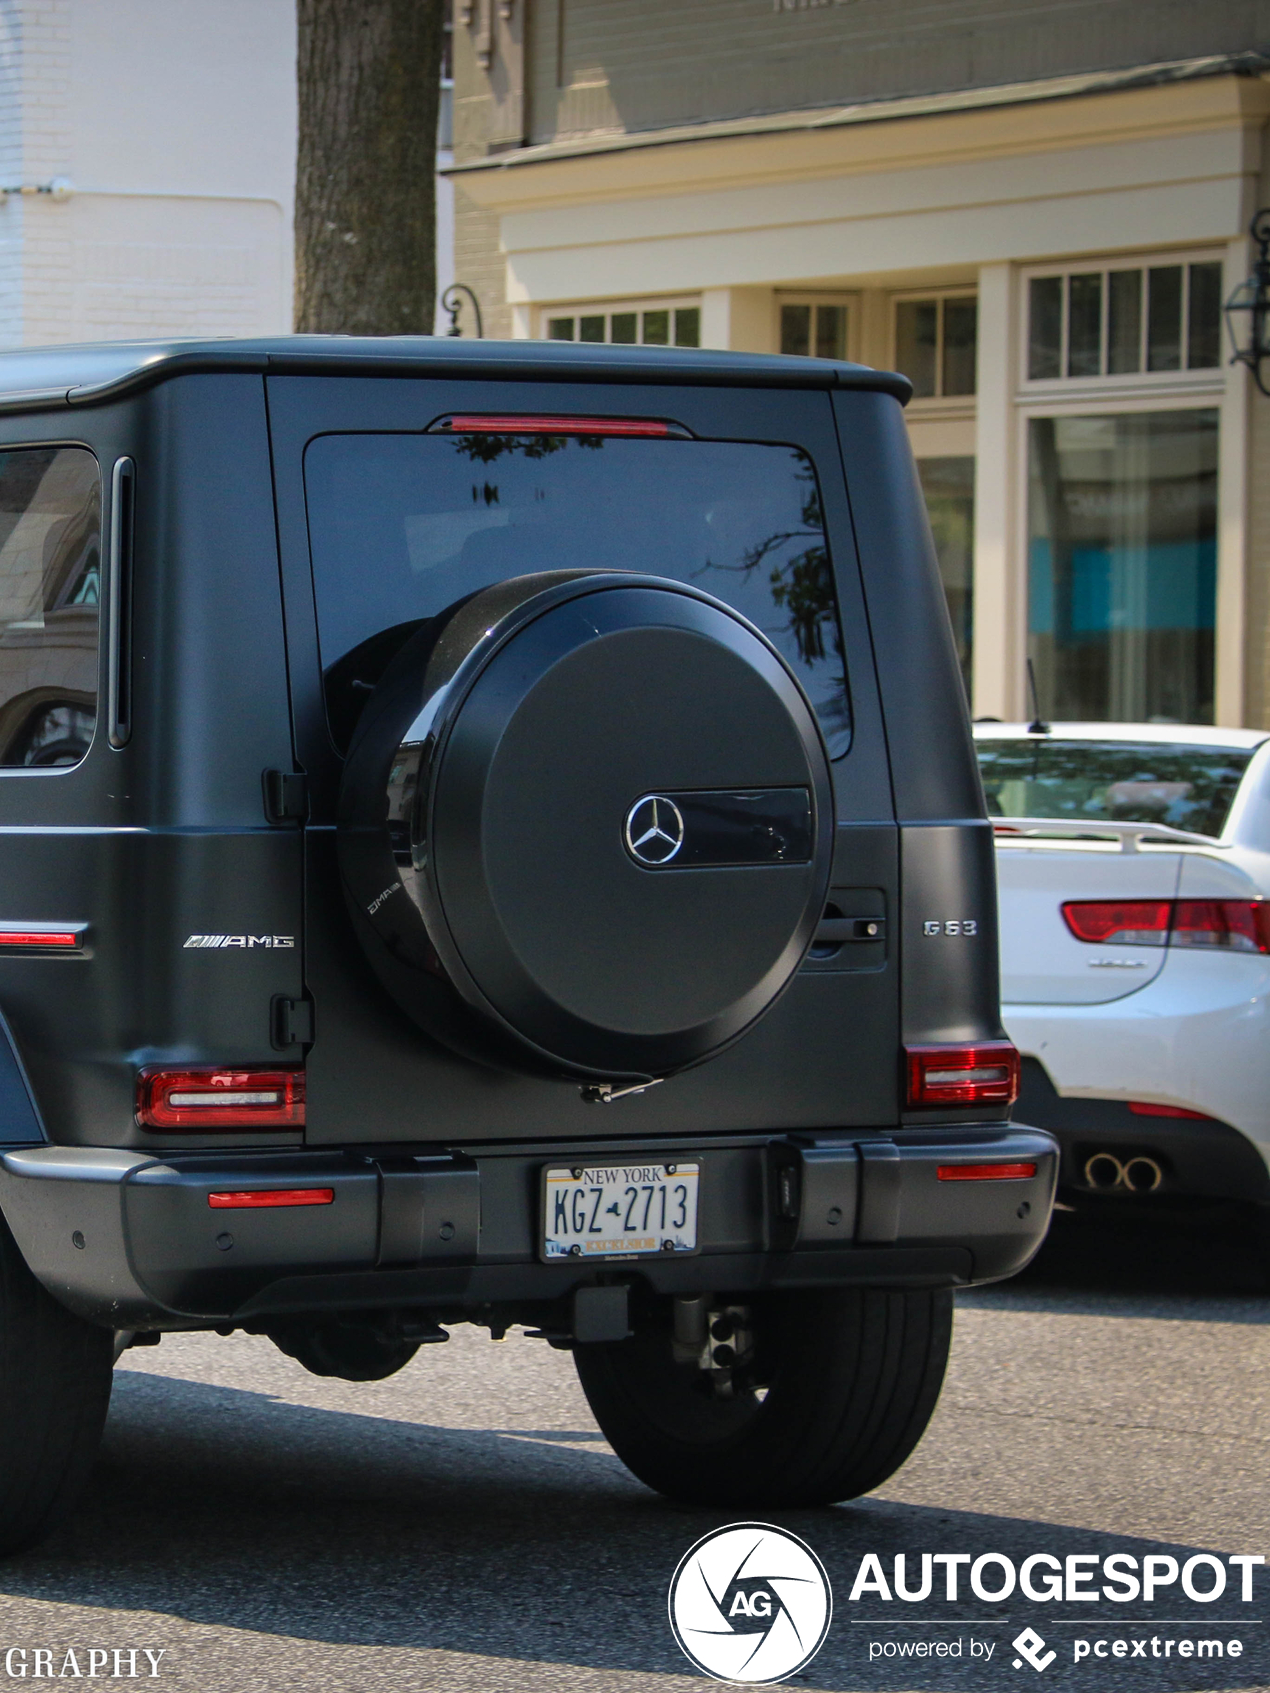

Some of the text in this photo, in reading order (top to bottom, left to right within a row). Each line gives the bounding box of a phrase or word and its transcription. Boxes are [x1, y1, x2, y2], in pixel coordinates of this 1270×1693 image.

[219, 935, 295, 948] AMG
[583, 1167, 663, 1185] NEW YORK
[585, 1236, 656, 1252] EXCELSIOR
